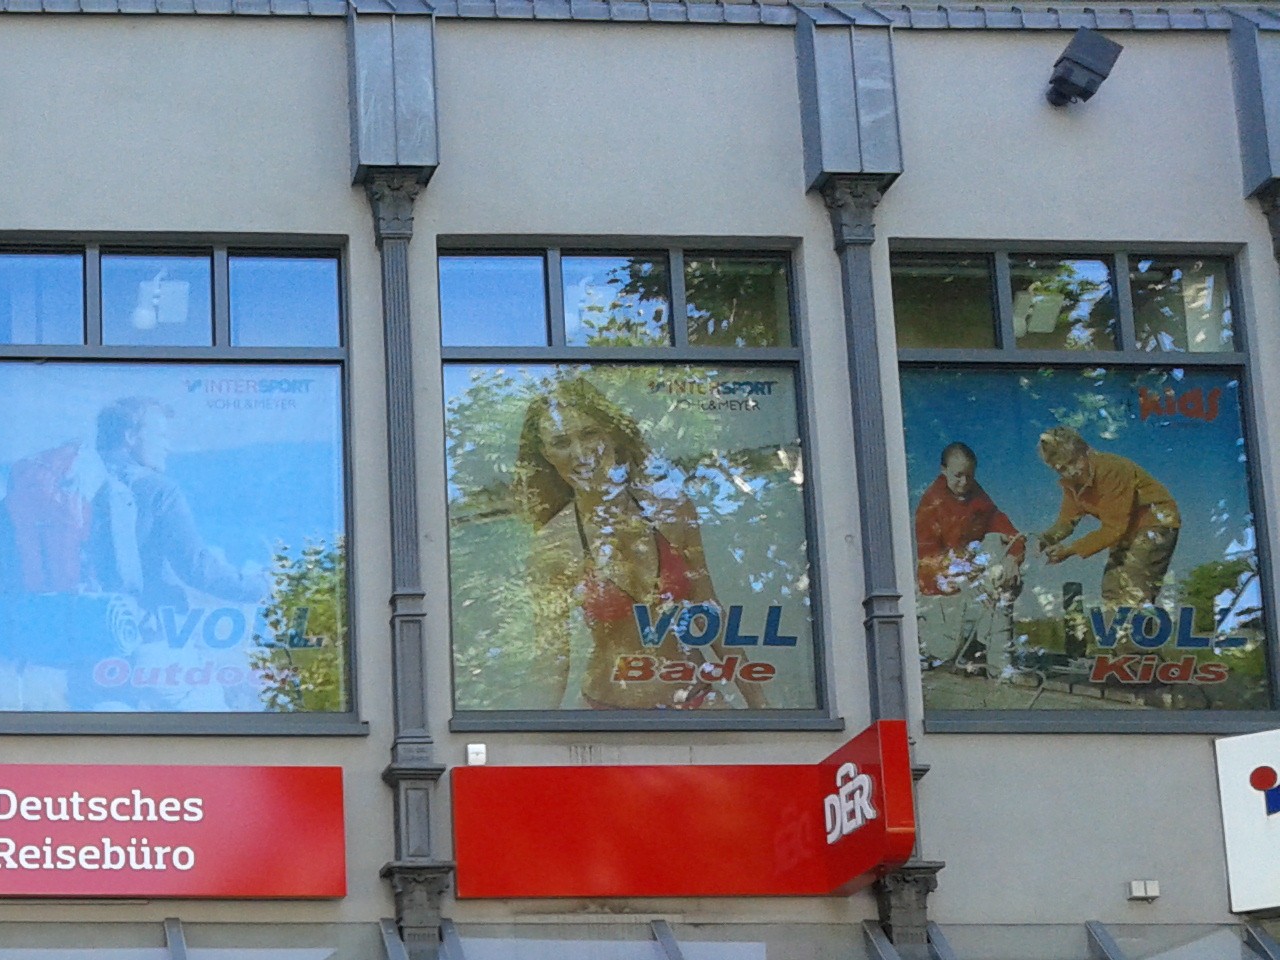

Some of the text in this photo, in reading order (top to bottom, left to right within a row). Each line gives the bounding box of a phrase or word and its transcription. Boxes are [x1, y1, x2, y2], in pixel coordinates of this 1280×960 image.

[204, 378, 315, 394] INTERSPORT
[634, 604, 799, 648] VOLL
[1090, 605, 1249, 649] VOLL
[612, 655, 777, 684] Bade
[1090, 655, 1229, 684] Kids
[823, 768, 877, 845] DER
